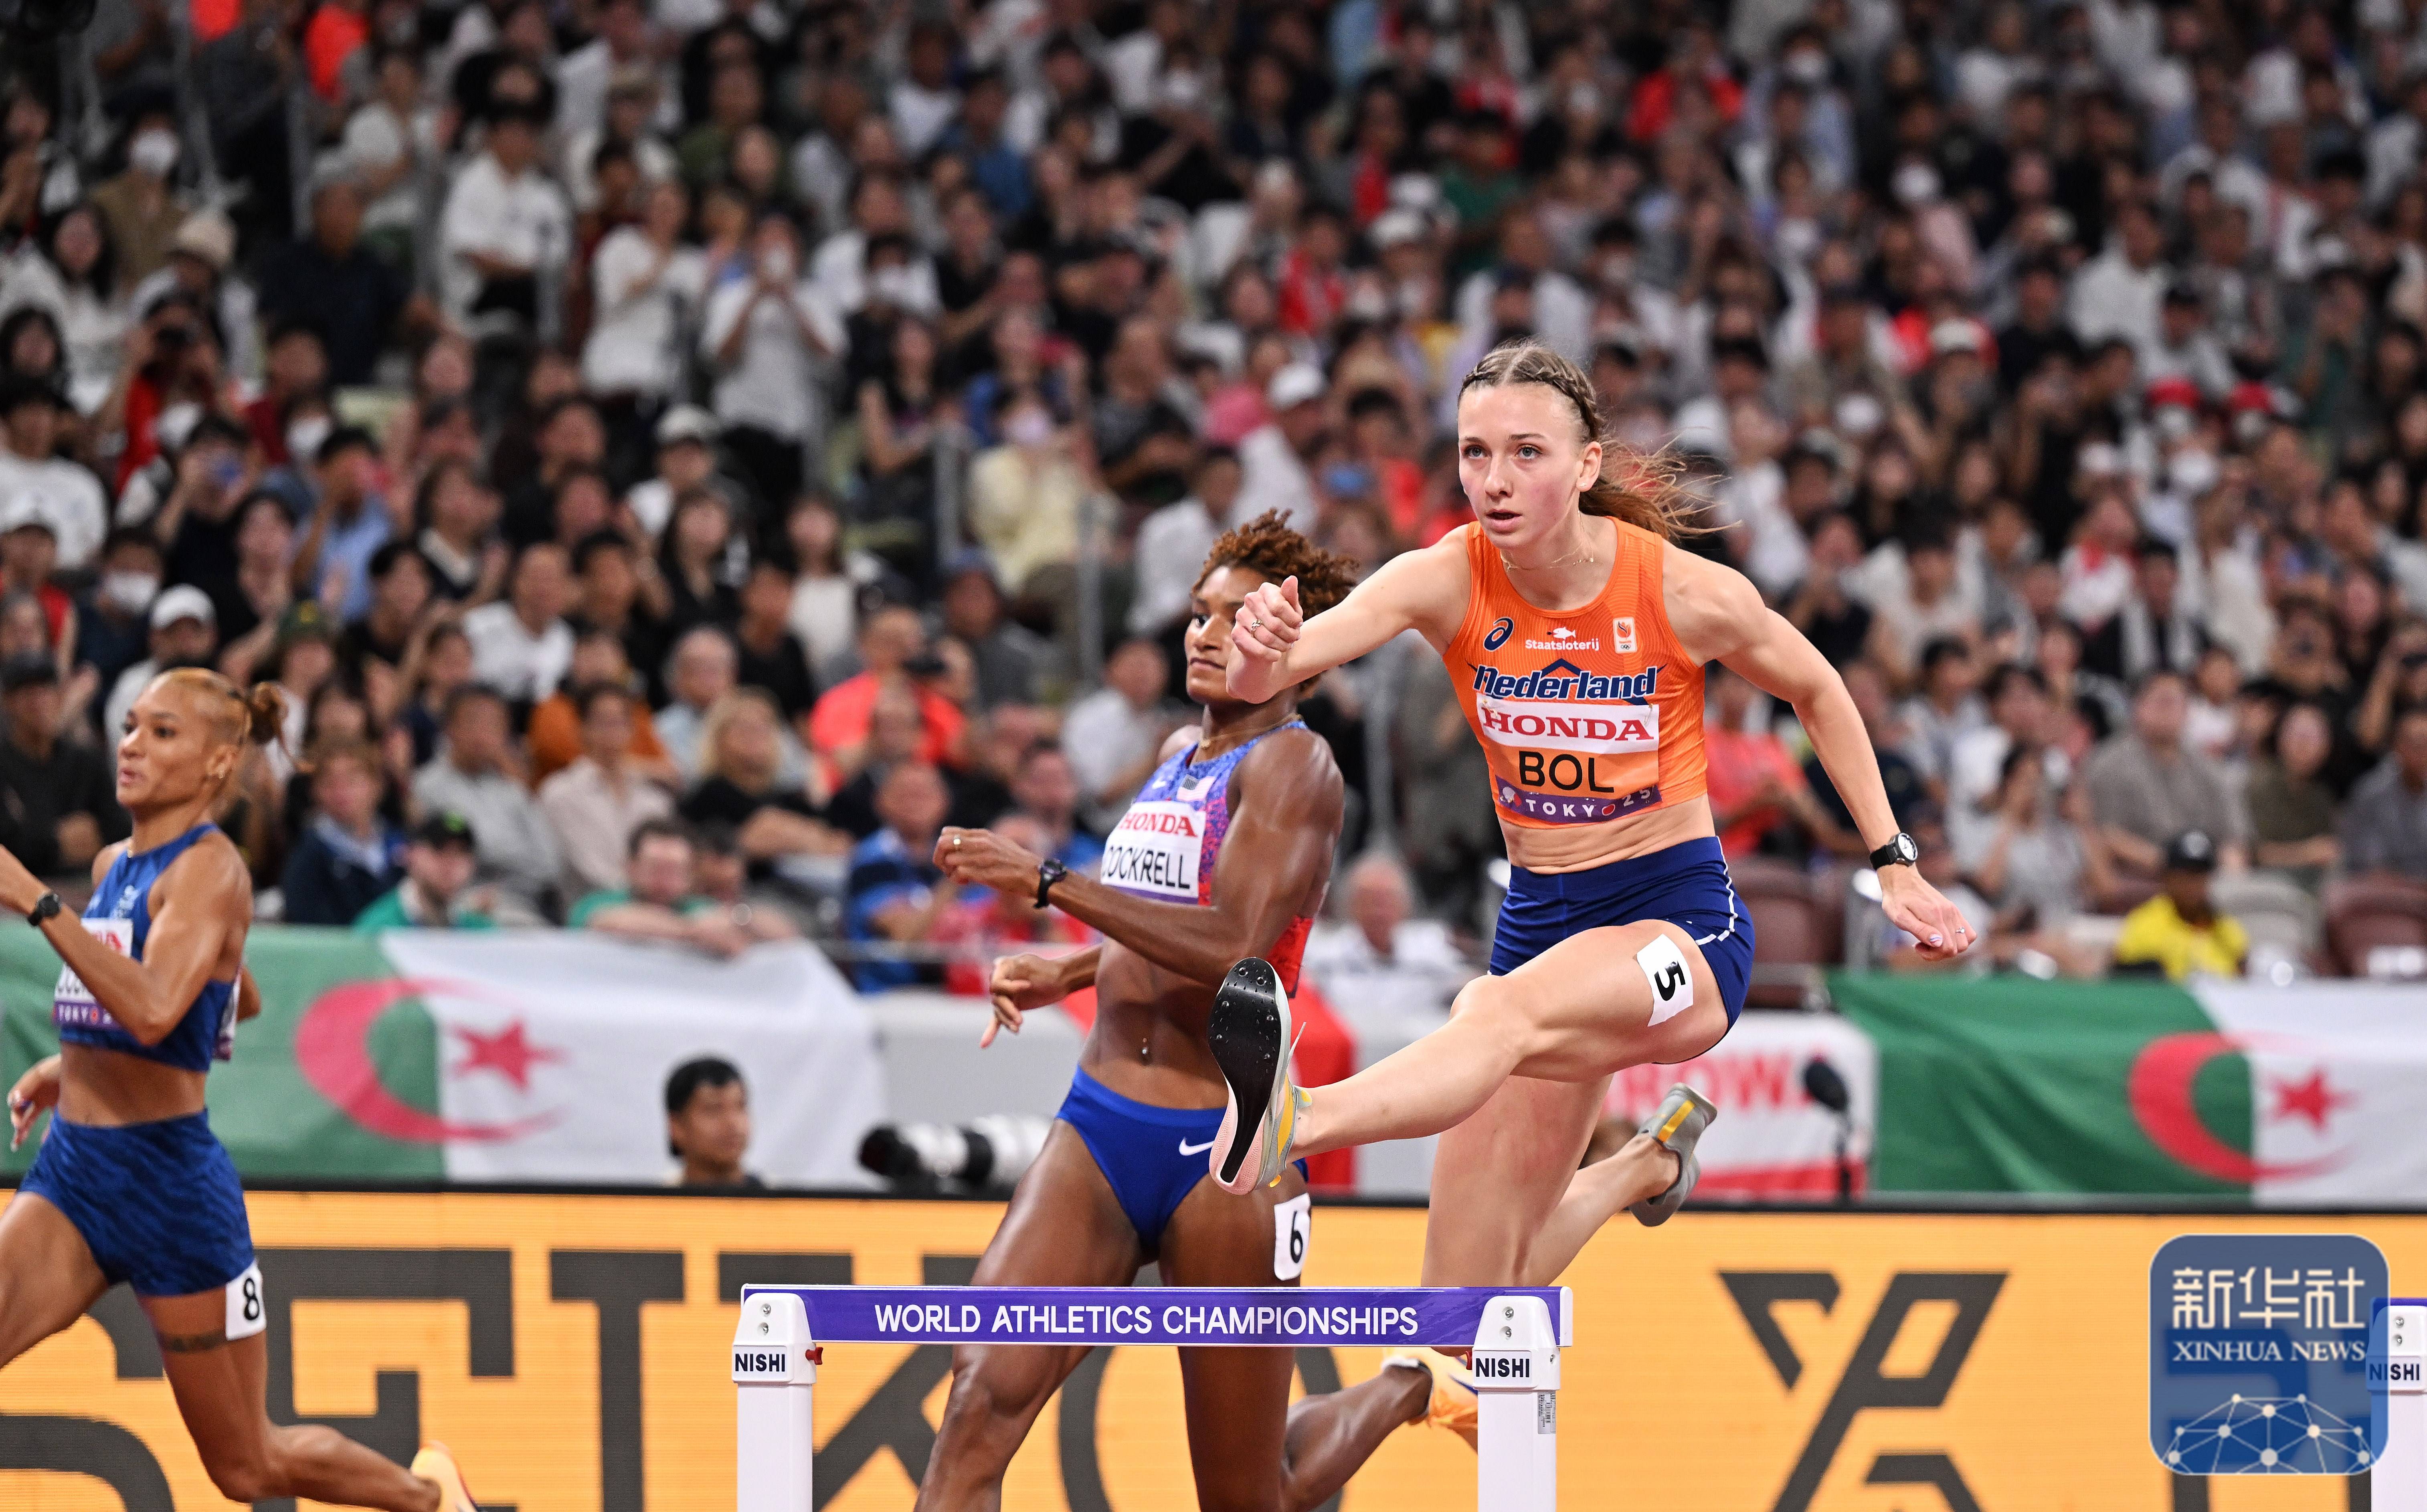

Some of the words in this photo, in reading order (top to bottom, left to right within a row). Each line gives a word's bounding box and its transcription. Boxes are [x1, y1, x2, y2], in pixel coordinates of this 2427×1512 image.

[1525, 638, 1600, 651] Staatsloterij
[1472, 664, 1657, 700] Nederland
[1481, 707, 1654, 741] HONDA
[1519, 751, 1614, 793] BOL
[1120, 813, 1198, 837] HONDA
[1654, 960, 1686, 1001] 5
[1290, 1211, 1303, 1263] 6
[243, 1278, 260, 1320] 8
[874, 1304, 981, 1333] WORLD
[991, 1305, 1153, 1334] ATHLETICS
[1162, 1306, 1418, 1335] CHAMPIONSHIPS
[735, 1353, 785, 1372] NISHI
[1476, 1358, 1530, 1378] NISHI
[2369, 1364, 2420, 1381] NISHI
